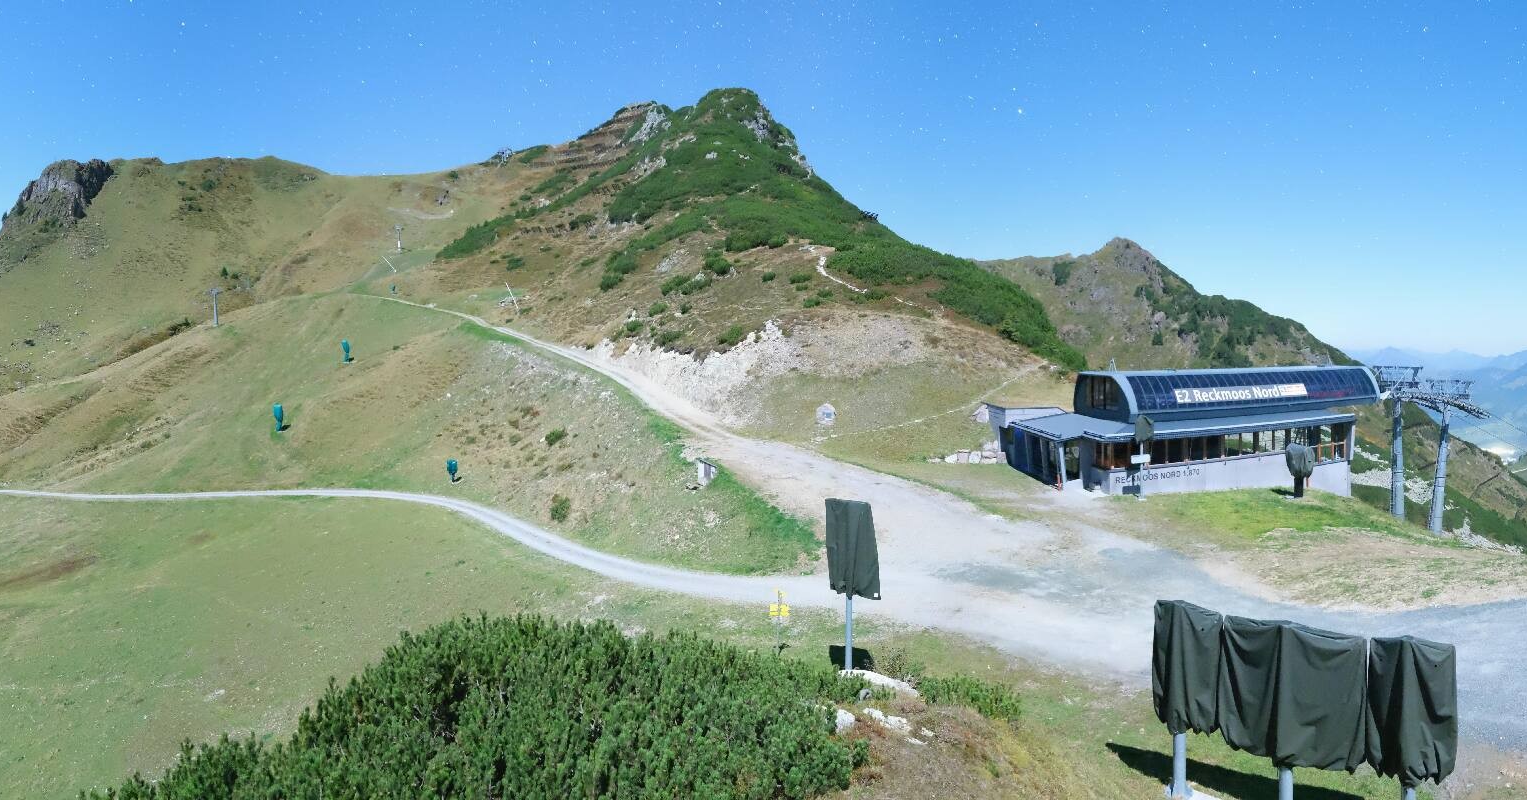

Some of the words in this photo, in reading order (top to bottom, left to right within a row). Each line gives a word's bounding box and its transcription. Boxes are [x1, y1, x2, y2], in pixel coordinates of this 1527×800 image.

[1175, 390, 1191, 403] E2
[1194, 387, 1251, 402] Reckmoos
[1253, 385, 1281, 399] Nord
[1160, 470, 1181, 480] NORD
